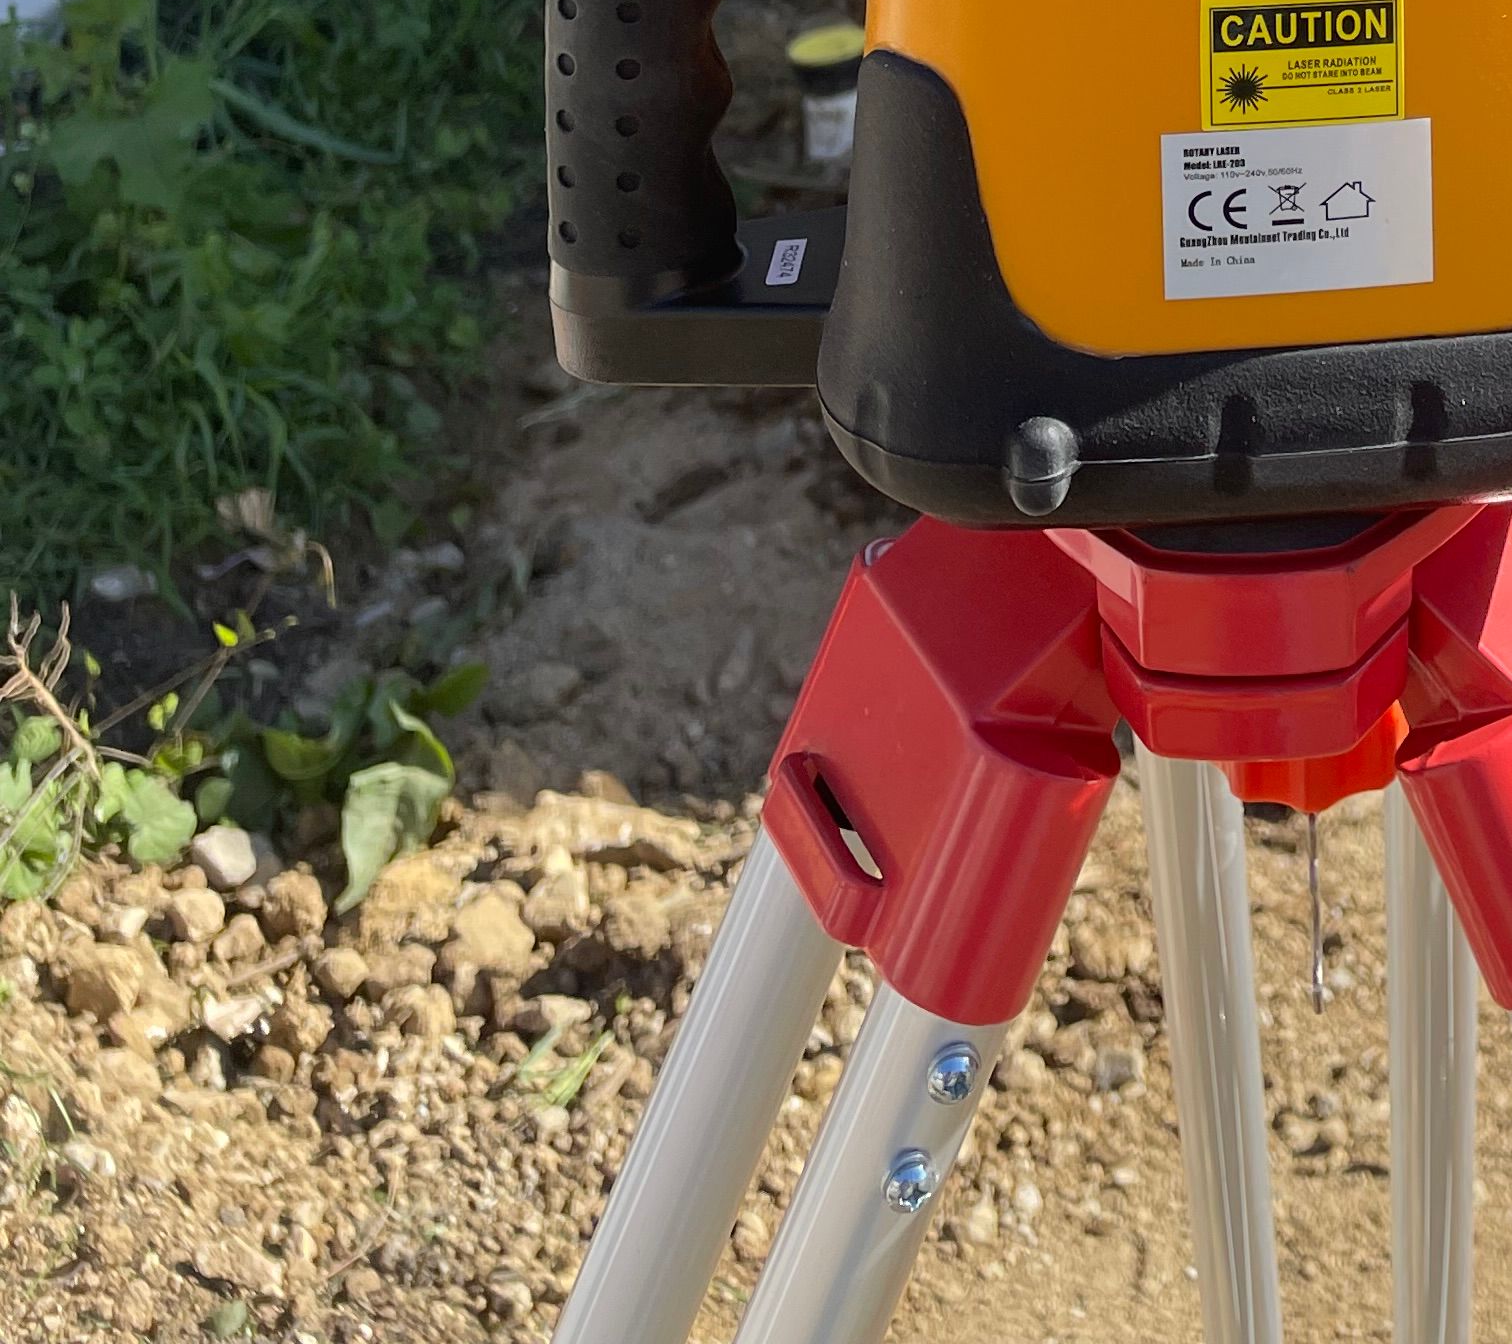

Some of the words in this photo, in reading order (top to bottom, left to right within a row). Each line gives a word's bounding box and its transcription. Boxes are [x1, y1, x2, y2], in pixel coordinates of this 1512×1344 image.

[1220, 7, 1387, 47] CAUTION
[1288, 59, 1320, 70] LASER
[1323, 56, 1377, 68] RADIATION
[1282, 72, 1293, 80] DO
[1295, 71, 1311, 80] NOT
[1313, 70, 1338, 79] STARE
[1340, 69, 1359, 77] INTO
[1360, 67, 1382, 76] BEAM
[1364, 85, 1391, 93] LASER
[1183, 147, 1215, 158] ROTARY
[1216, 146, 1240, 156] LASER
[1183, 161, 1211, 170] Model:
[1283, 229, 1316, 242] Trading
[1181, 258, 1204, 267] Made
[1210, 257, 1221, 266] In
[1226, 255, 1255, 265] China
